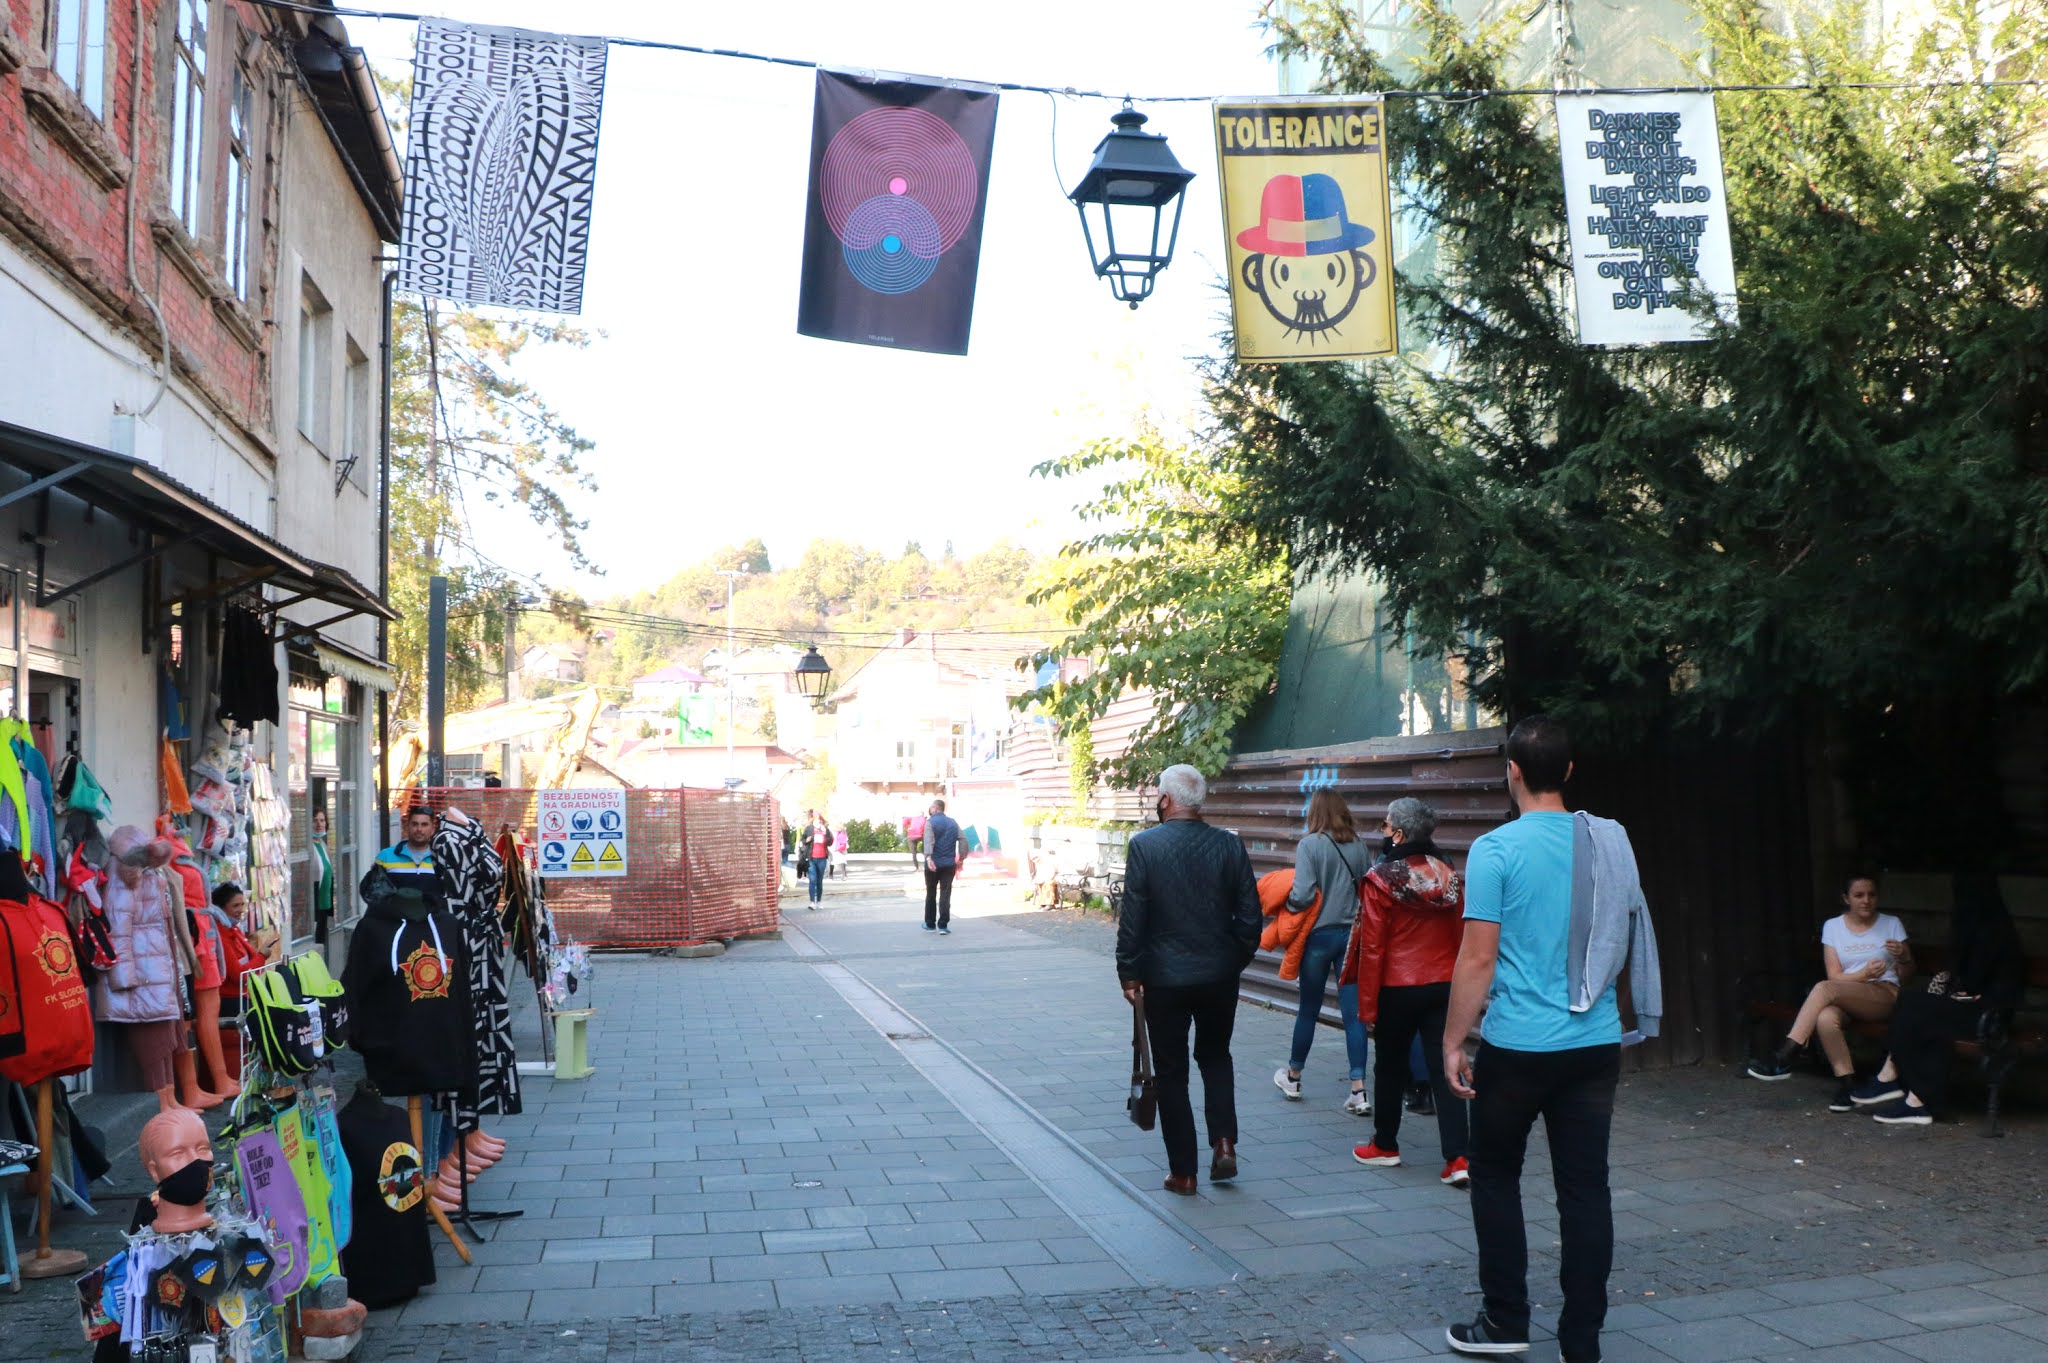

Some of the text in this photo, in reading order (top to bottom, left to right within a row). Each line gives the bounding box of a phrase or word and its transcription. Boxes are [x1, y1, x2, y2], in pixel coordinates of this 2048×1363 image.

[1220, 114, 1379, 148] TOLERANCE
[1603, 127, 1678, 144] CANNOT
[1586, 141, 1682, 160] DRIVE OUT
[1605, 157, 1697, 175] DARKNESS;
[1633, 172, 1684, 188] ONLY
[1642, 187, 1681, 203] CAN
[1682, 186, 1711, 203] DO
[1638, 215, 1708, 233] CANNOT
[1608, 231, 1702, 249] DRIVE OUT
[1598, 261, 1645, 279] ONLY
[1623, 276, 1663, 293] CAN
[1613, 292, 1642, 310] DO
[544, 792, 620, 800] BEZBJEDNOST
